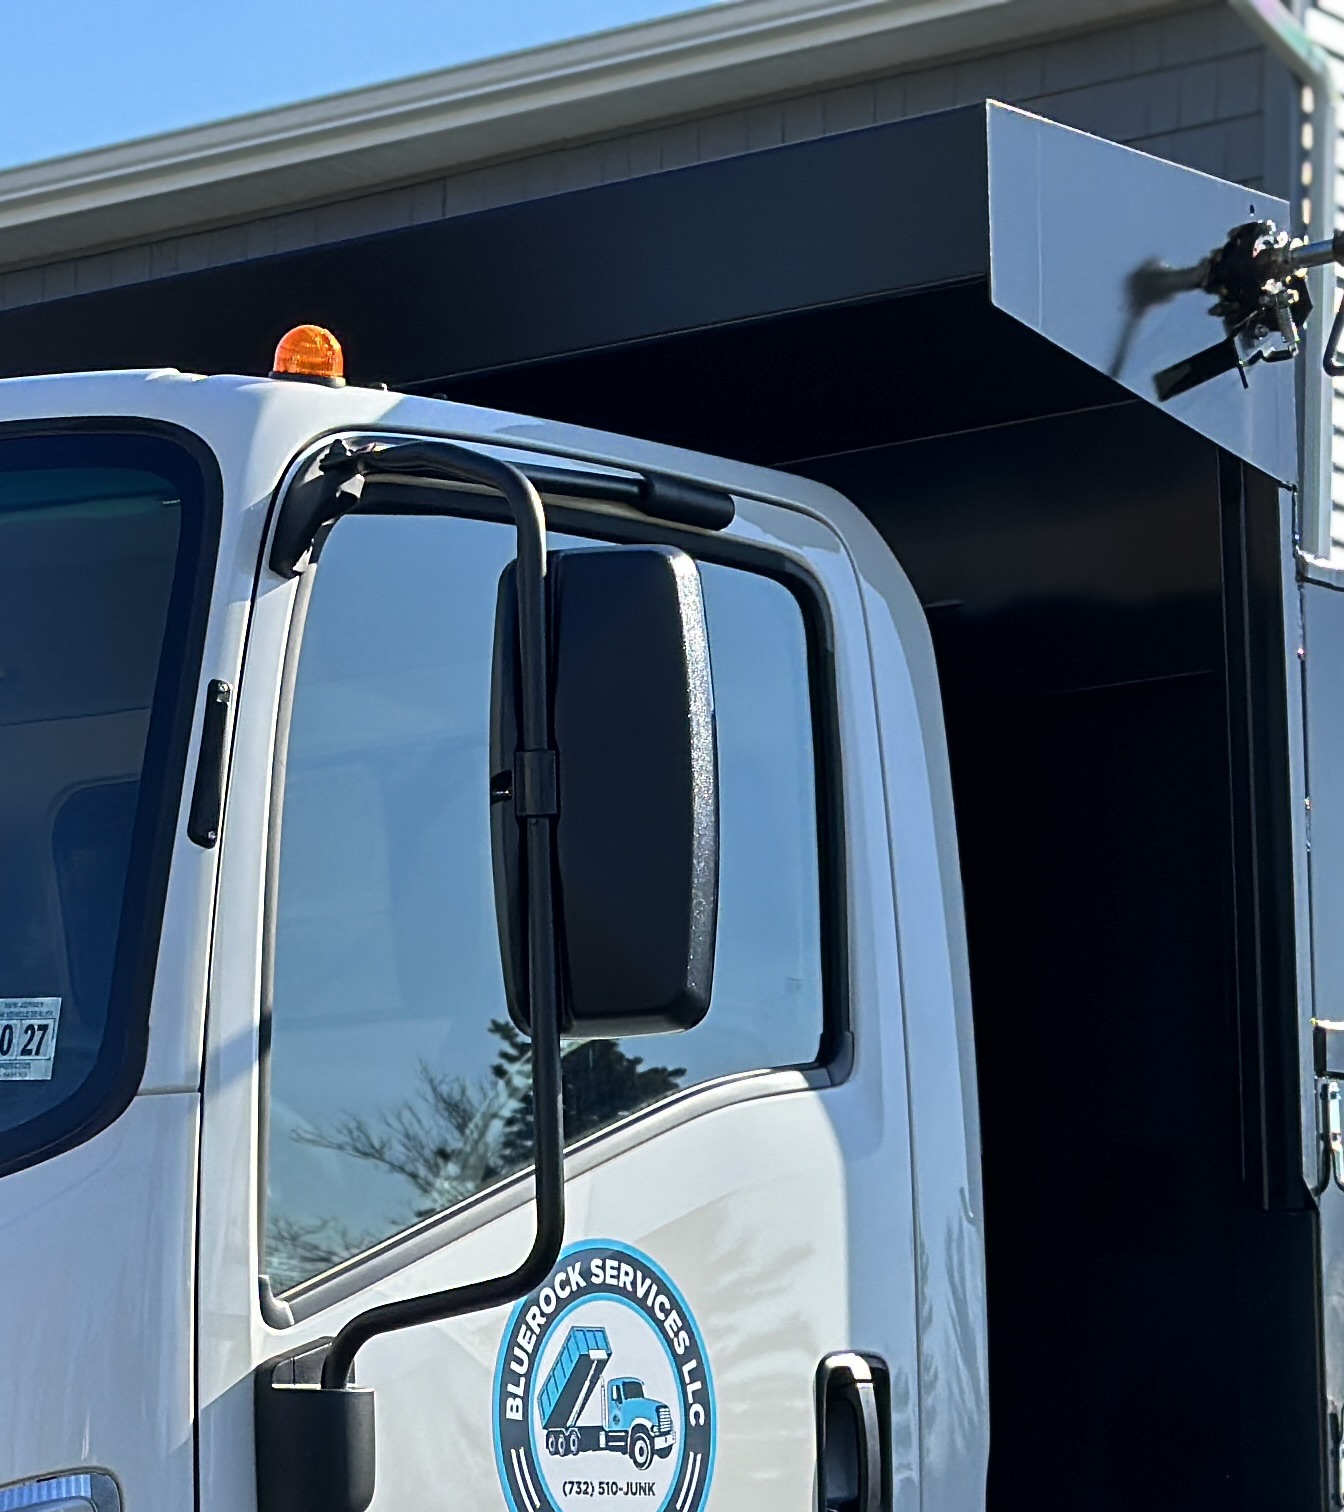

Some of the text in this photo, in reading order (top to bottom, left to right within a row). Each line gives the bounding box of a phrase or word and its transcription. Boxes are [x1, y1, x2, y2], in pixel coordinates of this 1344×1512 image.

[20, 1024, 49, 1056] 27
[506, 1259, 705, 1427] BLUEROCK SERVICES LLC
[562, 1481, 656, 1498] (732) 510-JUNK
